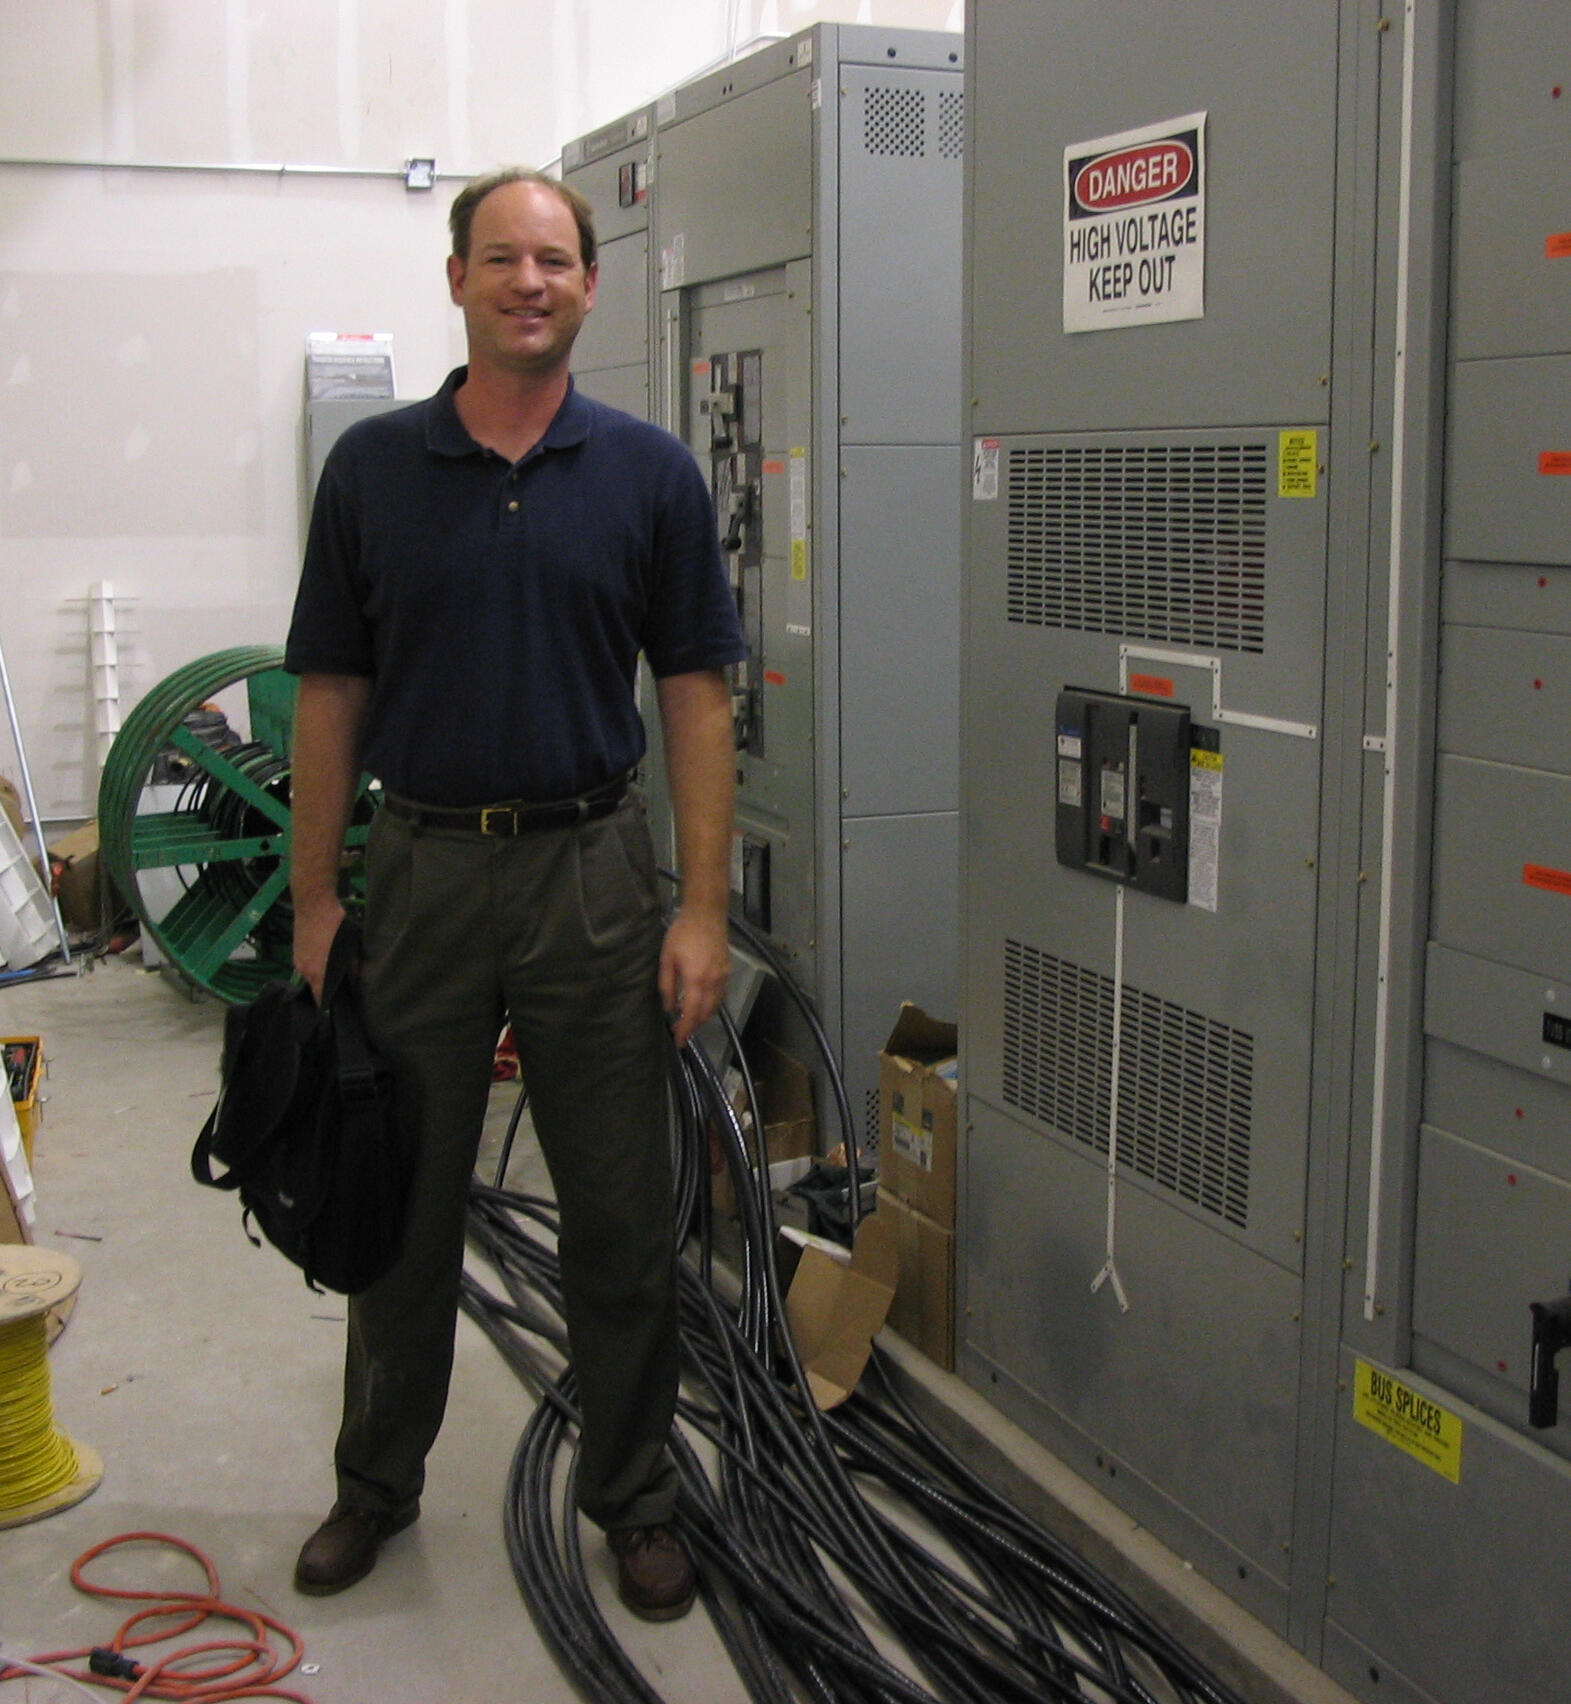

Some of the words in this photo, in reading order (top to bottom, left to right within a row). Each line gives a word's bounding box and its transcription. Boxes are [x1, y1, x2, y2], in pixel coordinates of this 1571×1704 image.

[1089, 152, 1178, 201] DANGER
[1070, 221, 1111, 264] HIGH
[1115, 207, 1197, 255] VOLTAGE
[1089, 262, 1133, 302] KEEP
[1138, 255, 1176, 295] OUT
[1371, 1372, 1392, 1405] BUS
[1395, 1386, 1441, 1435] SPLICES
